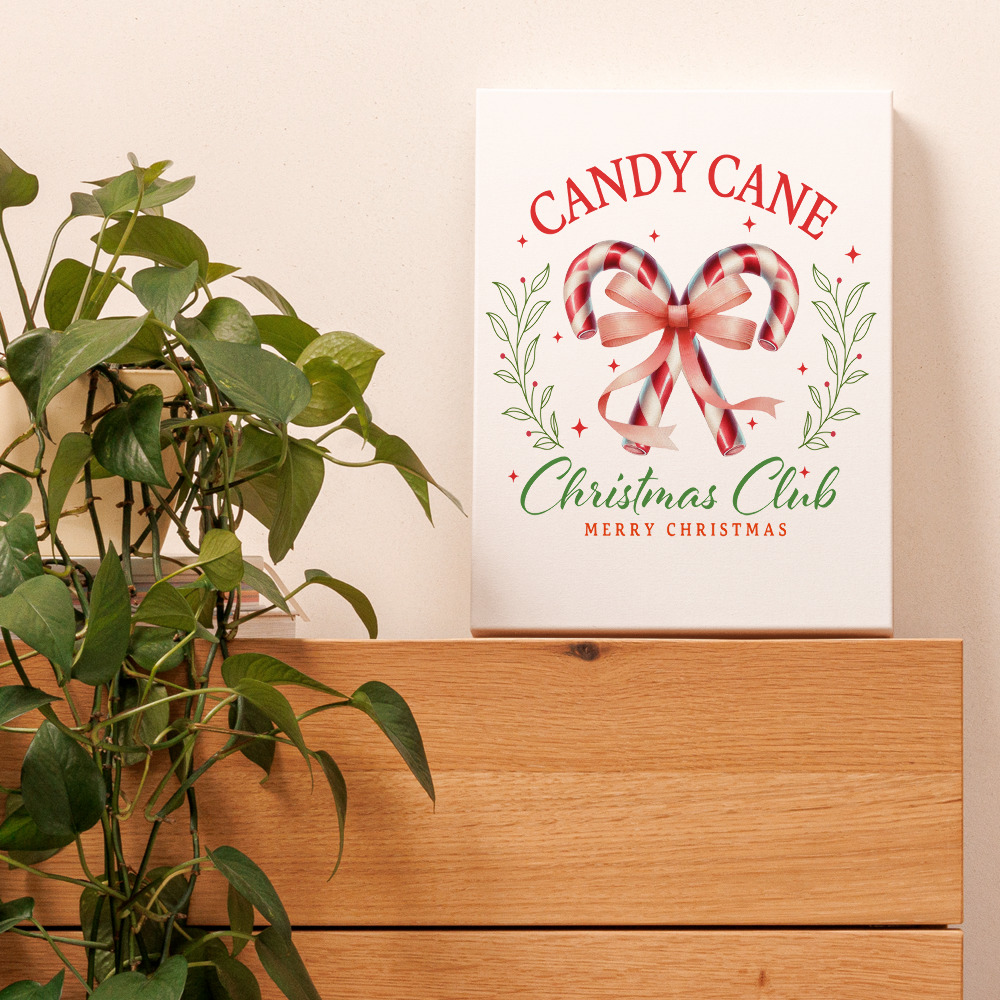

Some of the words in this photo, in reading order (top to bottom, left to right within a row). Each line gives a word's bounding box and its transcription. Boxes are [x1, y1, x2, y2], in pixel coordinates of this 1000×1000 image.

[529, 150, 698, 235] CANDY
[707, 154, 839, 241] CANE
[519, 455, 718, 516] Christmas
[732, 455, 840, 516] Club
[584, 522, 656, 537] MERRY
[666, 522, 788, 537] CHRISTMAS
